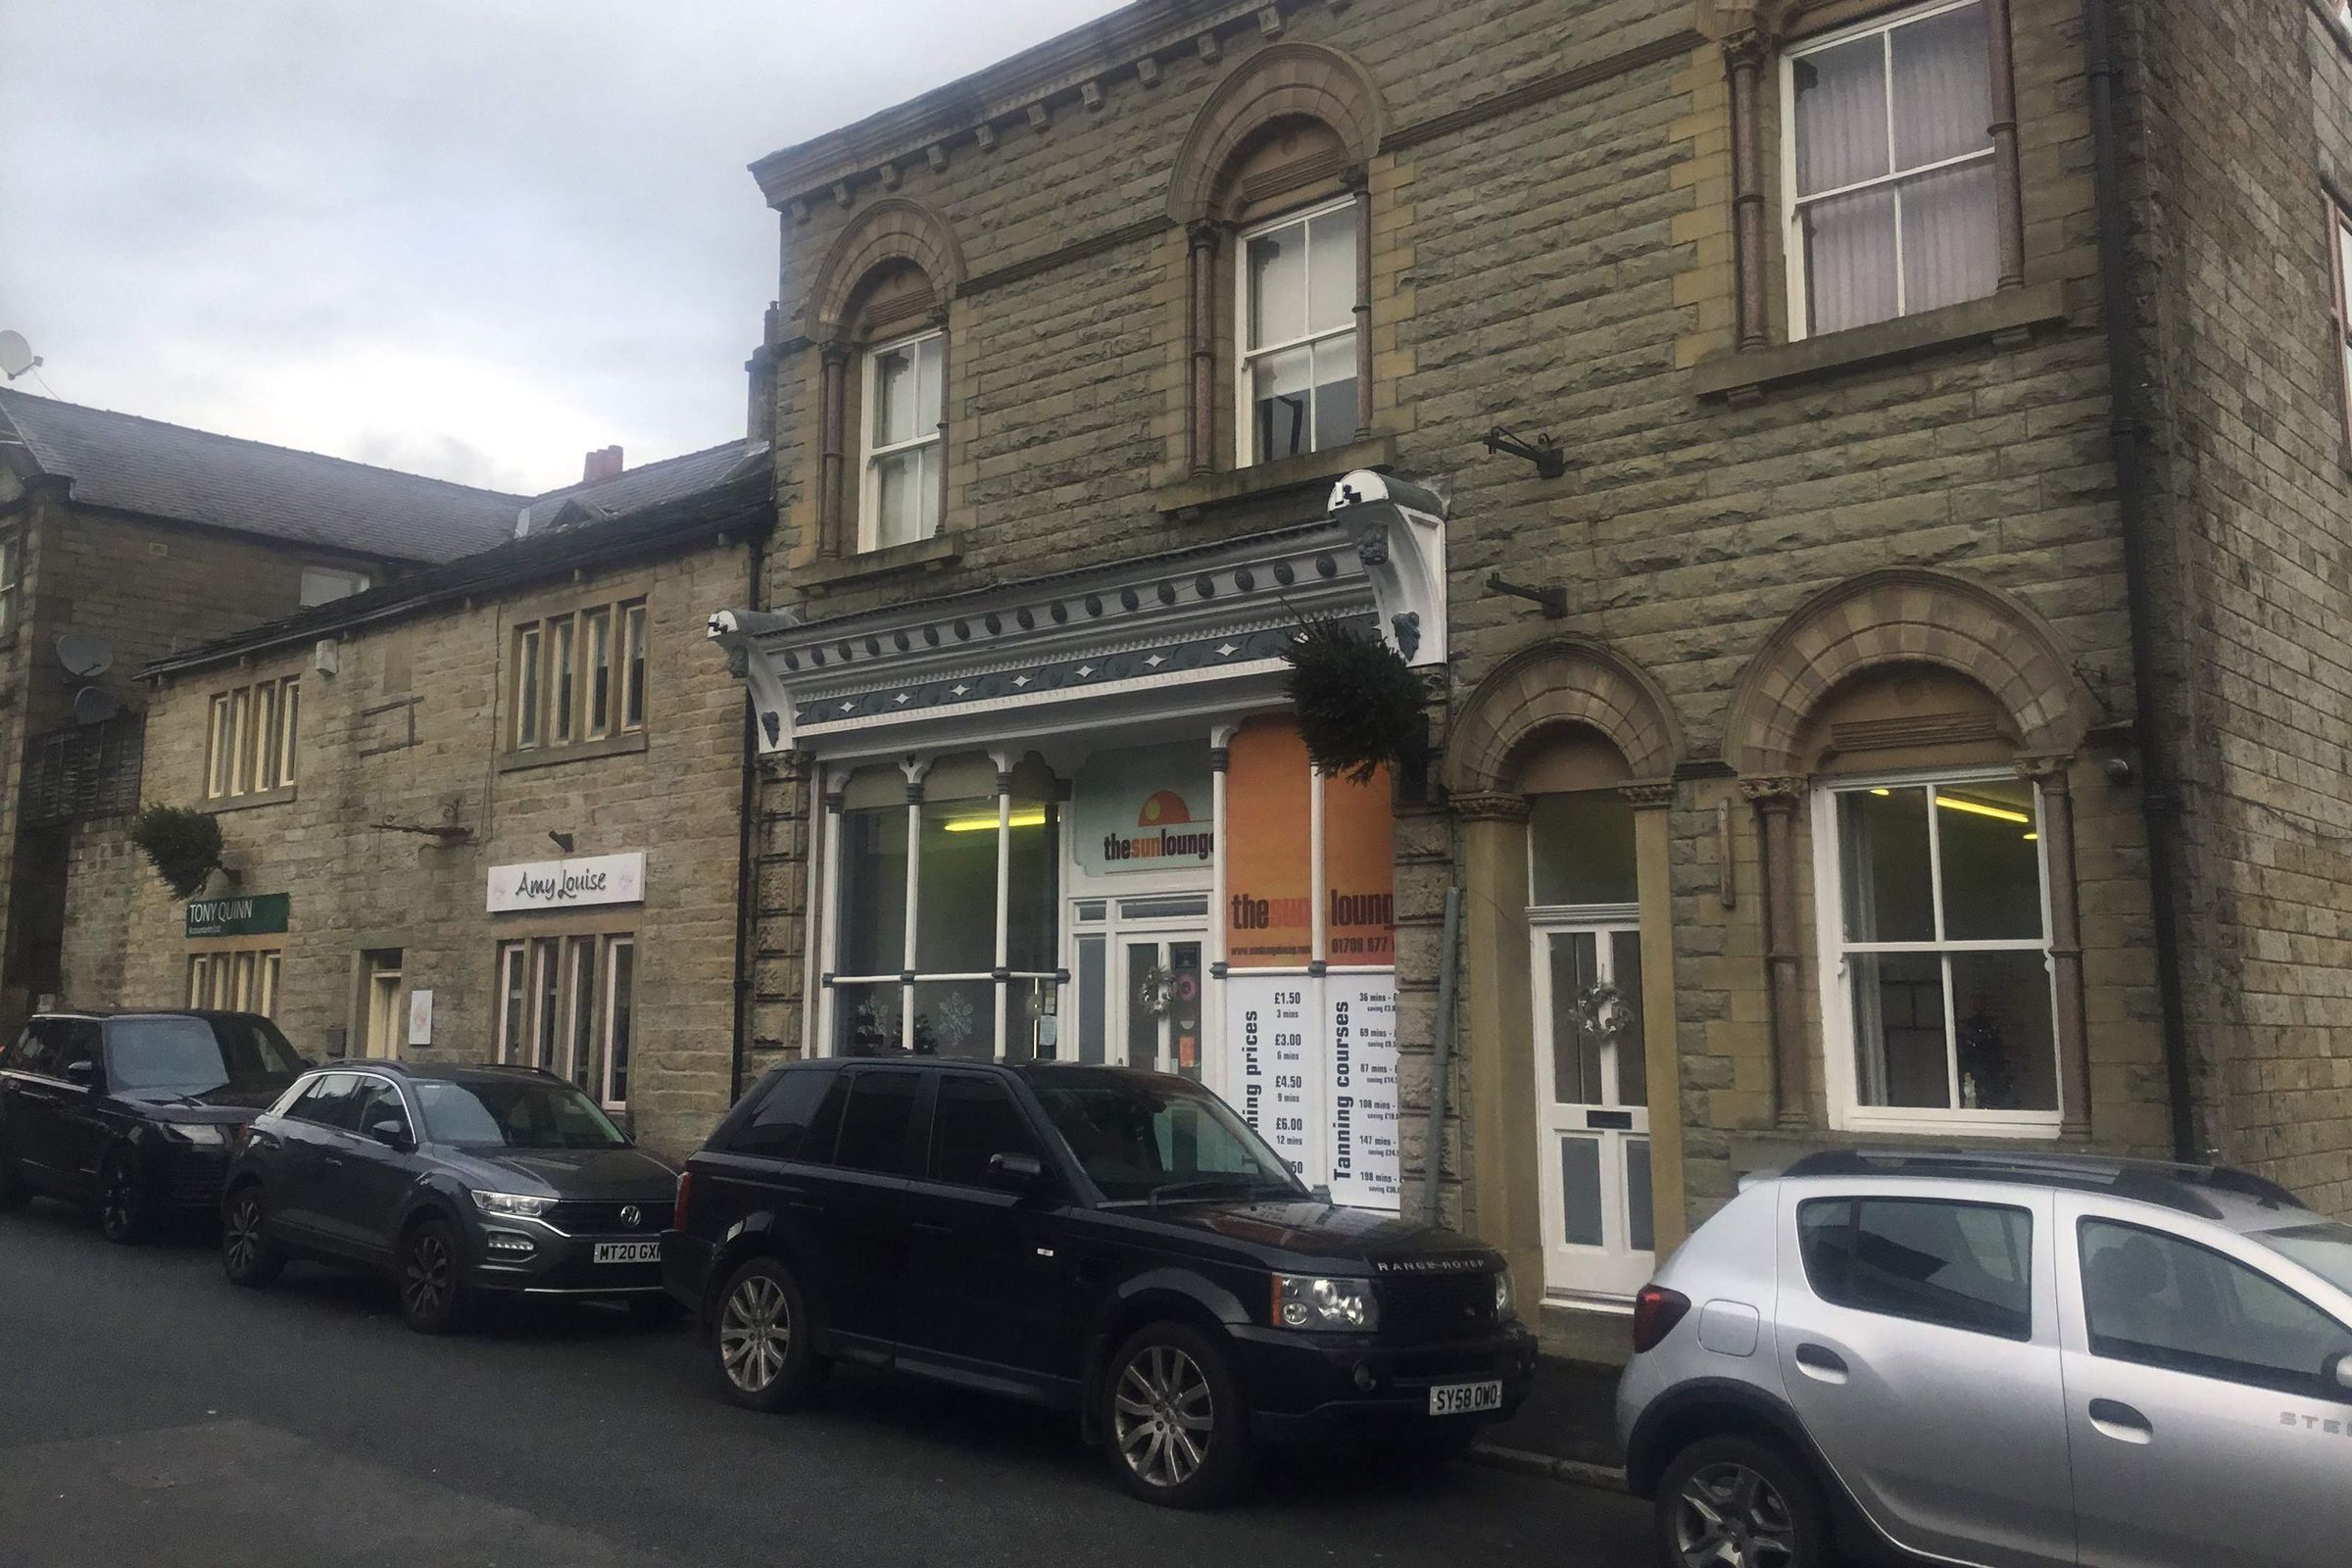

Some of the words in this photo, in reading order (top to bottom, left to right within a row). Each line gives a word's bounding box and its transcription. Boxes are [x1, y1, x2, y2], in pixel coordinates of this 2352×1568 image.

[514, 871, 556, 901] Amy
[557, 867, 608, 900] Louise
[189, 902, 218, 923] TONY
[218, 900, 253, 922] QUINN
[1330, 889, 1396, 931] loung
[1274, 992, 1300, 1004] £1.50
[1369, 993, 1387, 1002] mins
[1276, 1009, 1282, 1018] 3
[1283, 1009, 1299, 1018] mins
[1370, 1028, 1387, 1038] mins
[1241, 1010, 1262, 1076] prices
[1274, 1033, 1301, 1046] £3.00
[1336, 1001, 1350, 1088] courses
[1283, 1051, 1299, 1060] mins
[1371, 1063, 1388, 1073] mins
[1275, 1075, 1302, 1088] £4.50
[1284, 1093, 1300, 1102] mins
[1359, 1099, 1373, 1108] 108
[1374, 1100, 1391, 1109] mins
[1276, 1118, 1303, 1131] £6.00
[1276, 1136, 1286, 1145] 12
[1286, 1137, 1303, 1146] mins
[1333, 1096, 1354, 1181] Tanning
[1359, 1135, 1373, 1145] 147
[1374, 1136, 1392, 1146] mins
[1375, 1173, 1393, 1183] mins
[600, 1245, 637, 1260] MT20
[1377, 1261, 1437, 1272] RANGE
[1437, 1388, 1472, 1411] SY58
